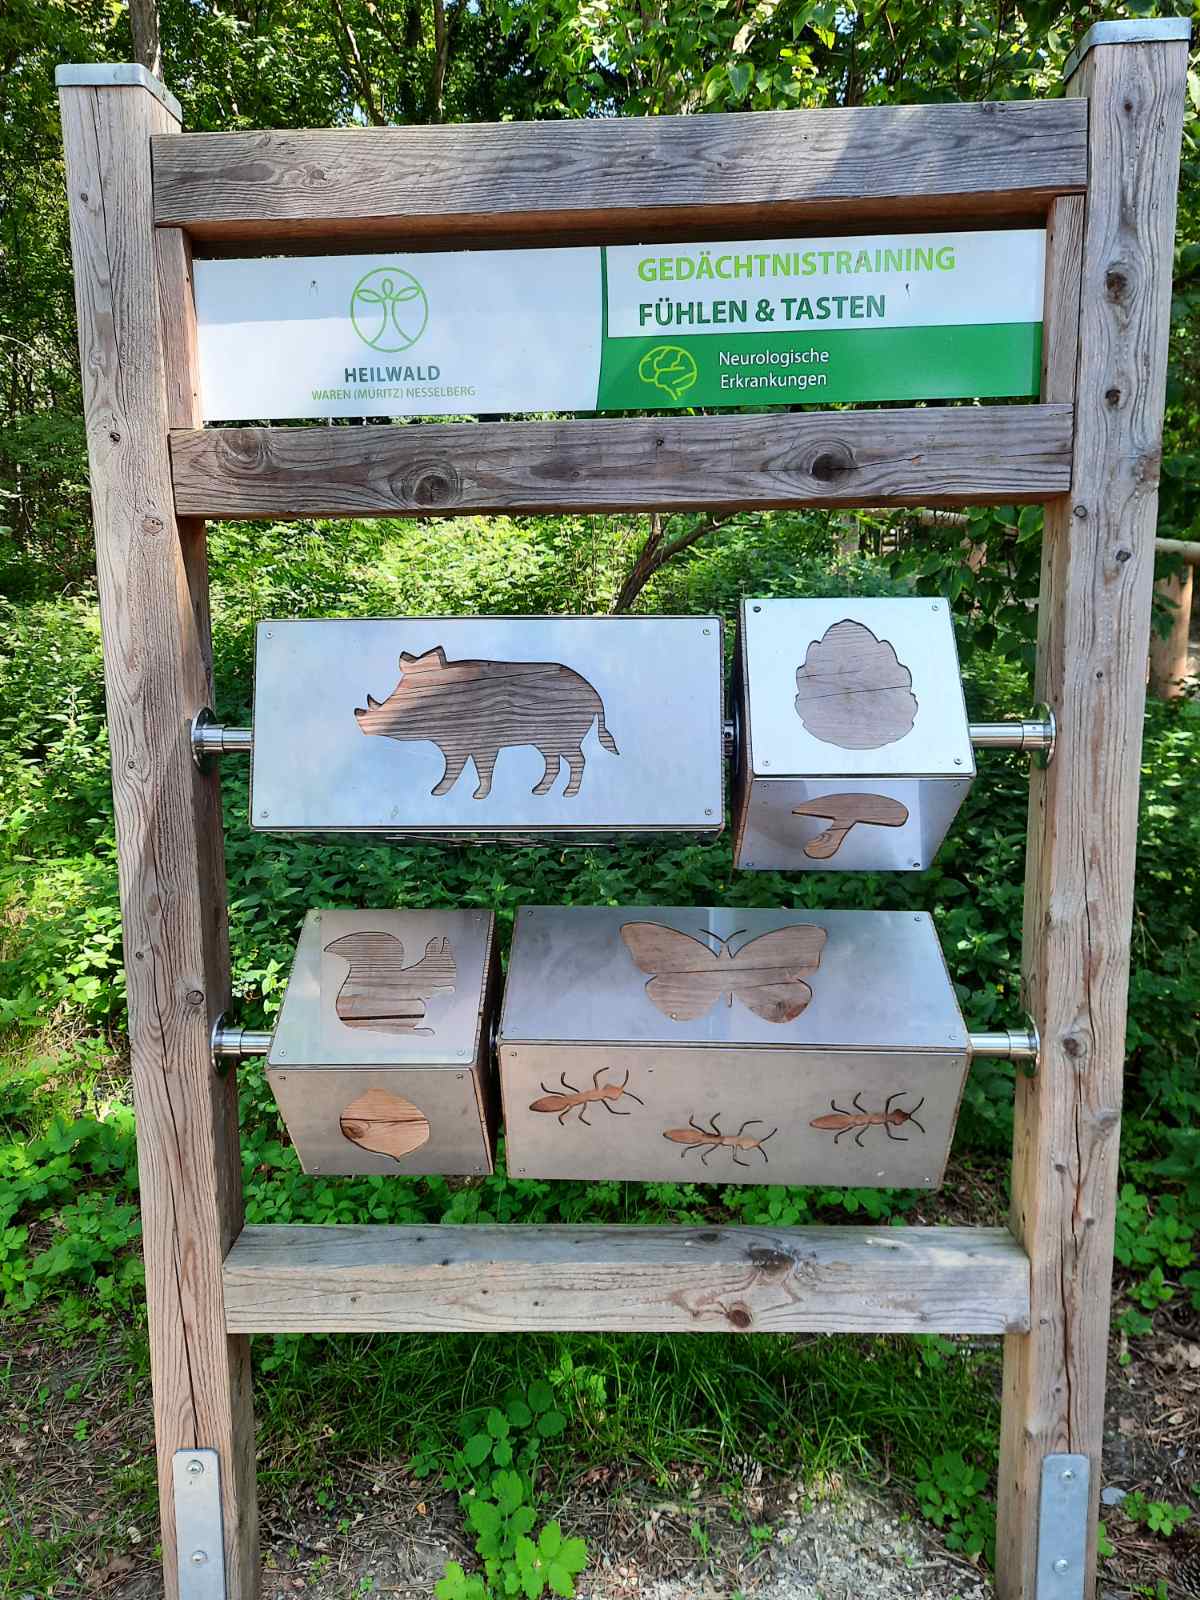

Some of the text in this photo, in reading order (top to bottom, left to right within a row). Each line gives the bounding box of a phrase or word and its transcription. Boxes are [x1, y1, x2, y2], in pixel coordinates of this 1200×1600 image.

[638, 246, 956, 282] GEDÄCHTNISTRAINING
[639, 294, 886, 326] FÜHLEN & TASTEN
[718, 347, 830, 367] Neurologische
[344, 365, 440, 383] HEILWALD
[720, 371, 828, 391] Erkrankungen
[311, 389, 352, 401] WAREN
[406, 386, 476, 399] NESSELBERG
